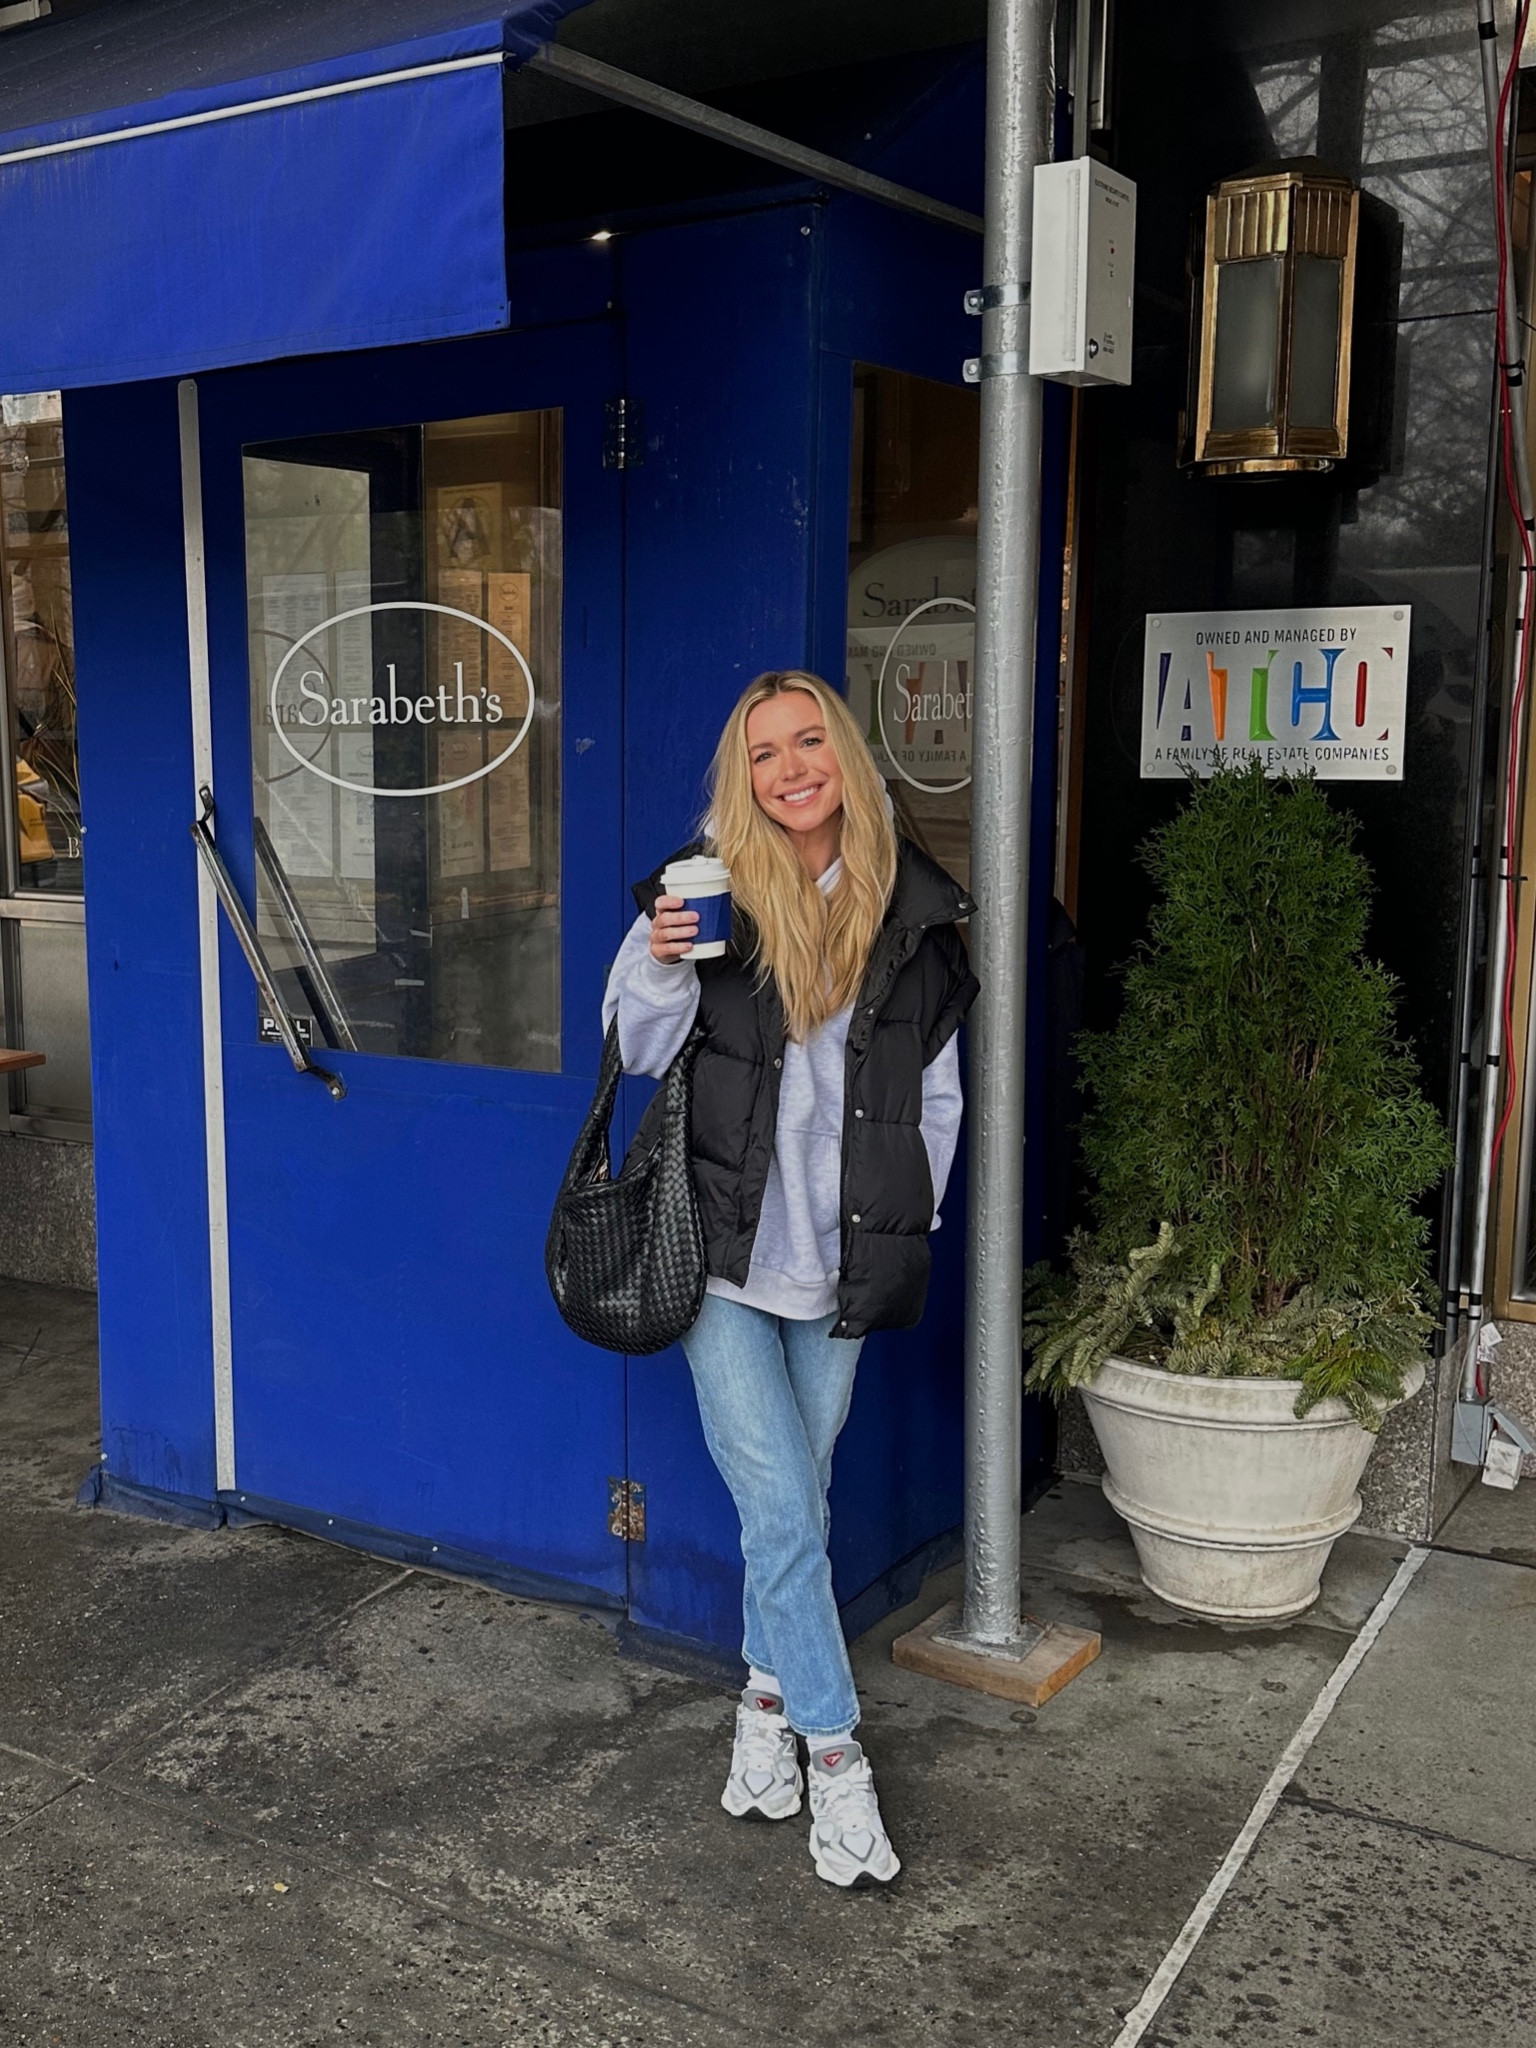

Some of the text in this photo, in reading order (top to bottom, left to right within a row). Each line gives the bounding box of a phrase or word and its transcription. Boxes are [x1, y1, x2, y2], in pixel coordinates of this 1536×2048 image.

[1196, 628, 1357, 645] OWNED AND MANAGED BY
[299, 662, 503, 726] Sarabeth's
[1154, 747, 1163, 760] A
[1166, 747, 1209, 760] FAMILY
[1267, 747, 1309, 760] ESTATE
[1315, 747, 1389, 760] COMPANIES
